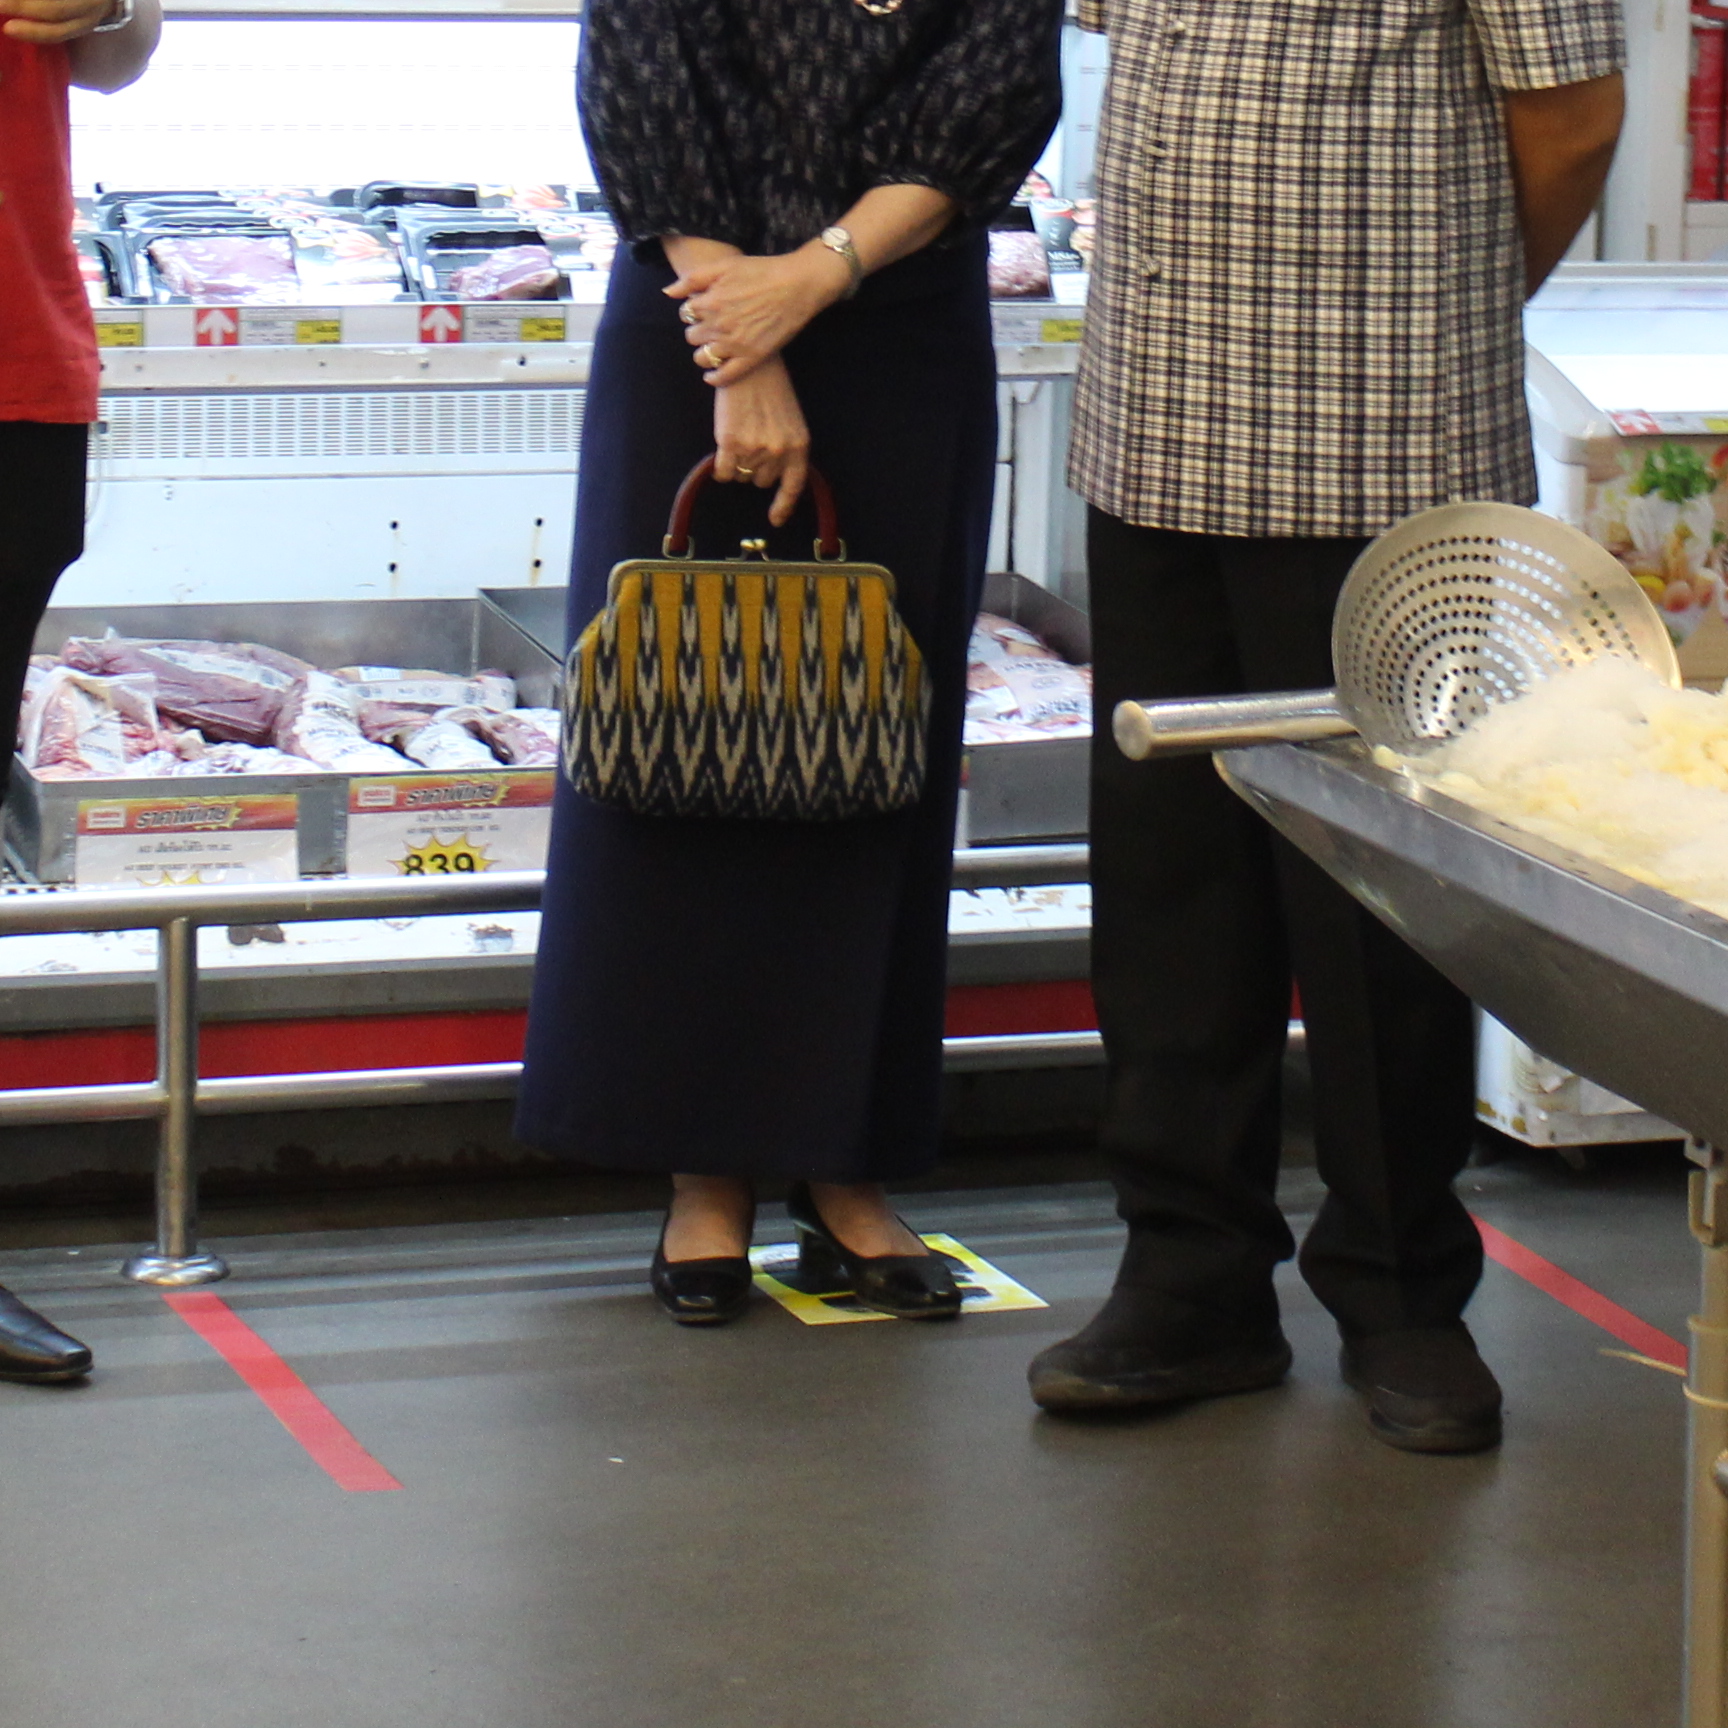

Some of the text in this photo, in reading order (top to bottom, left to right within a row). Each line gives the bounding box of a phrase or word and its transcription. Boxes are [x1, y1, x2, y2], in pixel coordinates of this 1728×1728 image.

[404, 782, 501, 806] ราคาพิเศษ
[135, 805, 230, 828] ราคาพิเศษ
